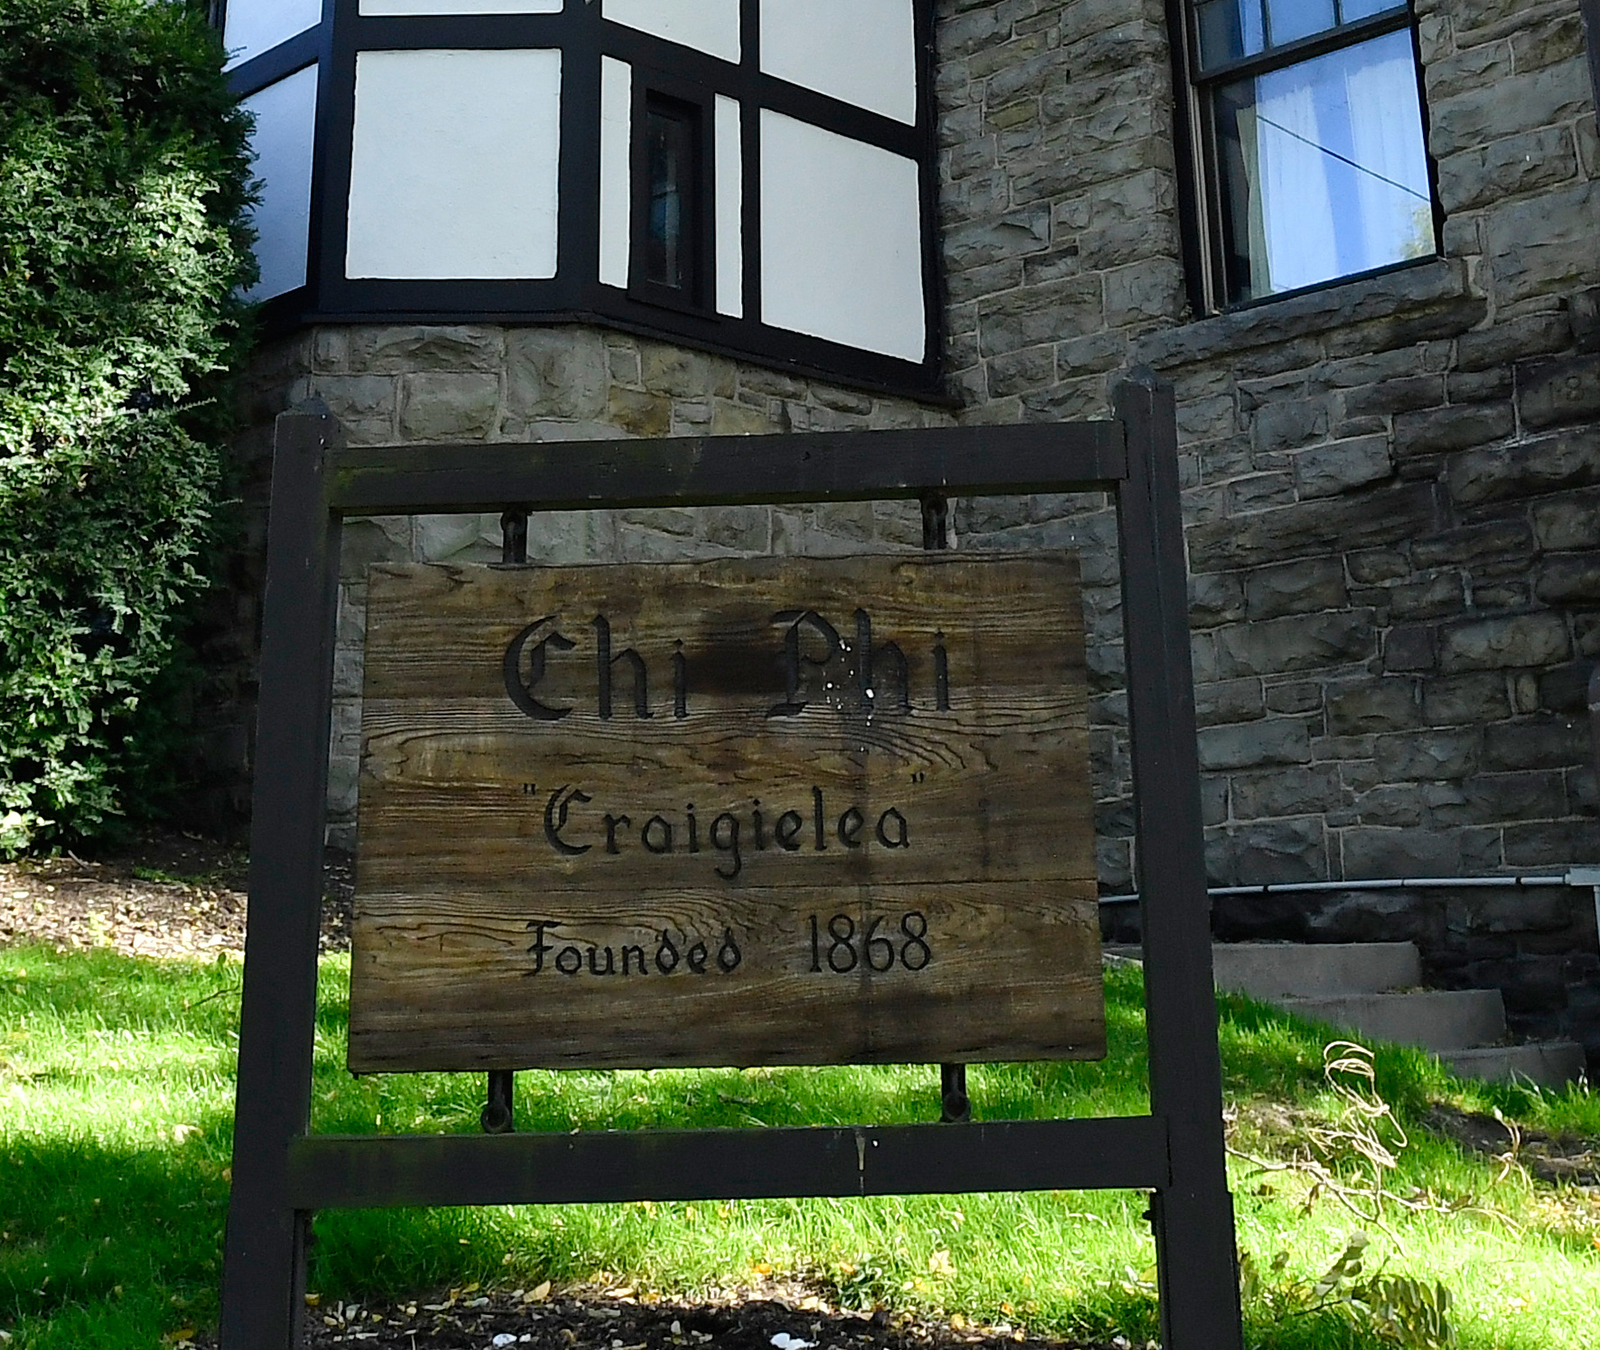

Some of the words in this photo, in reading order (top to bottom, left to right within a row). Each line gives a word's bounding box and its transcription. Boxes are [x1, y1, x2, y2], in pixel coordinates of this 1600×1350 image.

[503, 614, 687, 721] Chi
[766, 607, 954, 717] Phi
[524, 920, 742, 976] Founded
[808, 911, 932, 973] 1868
